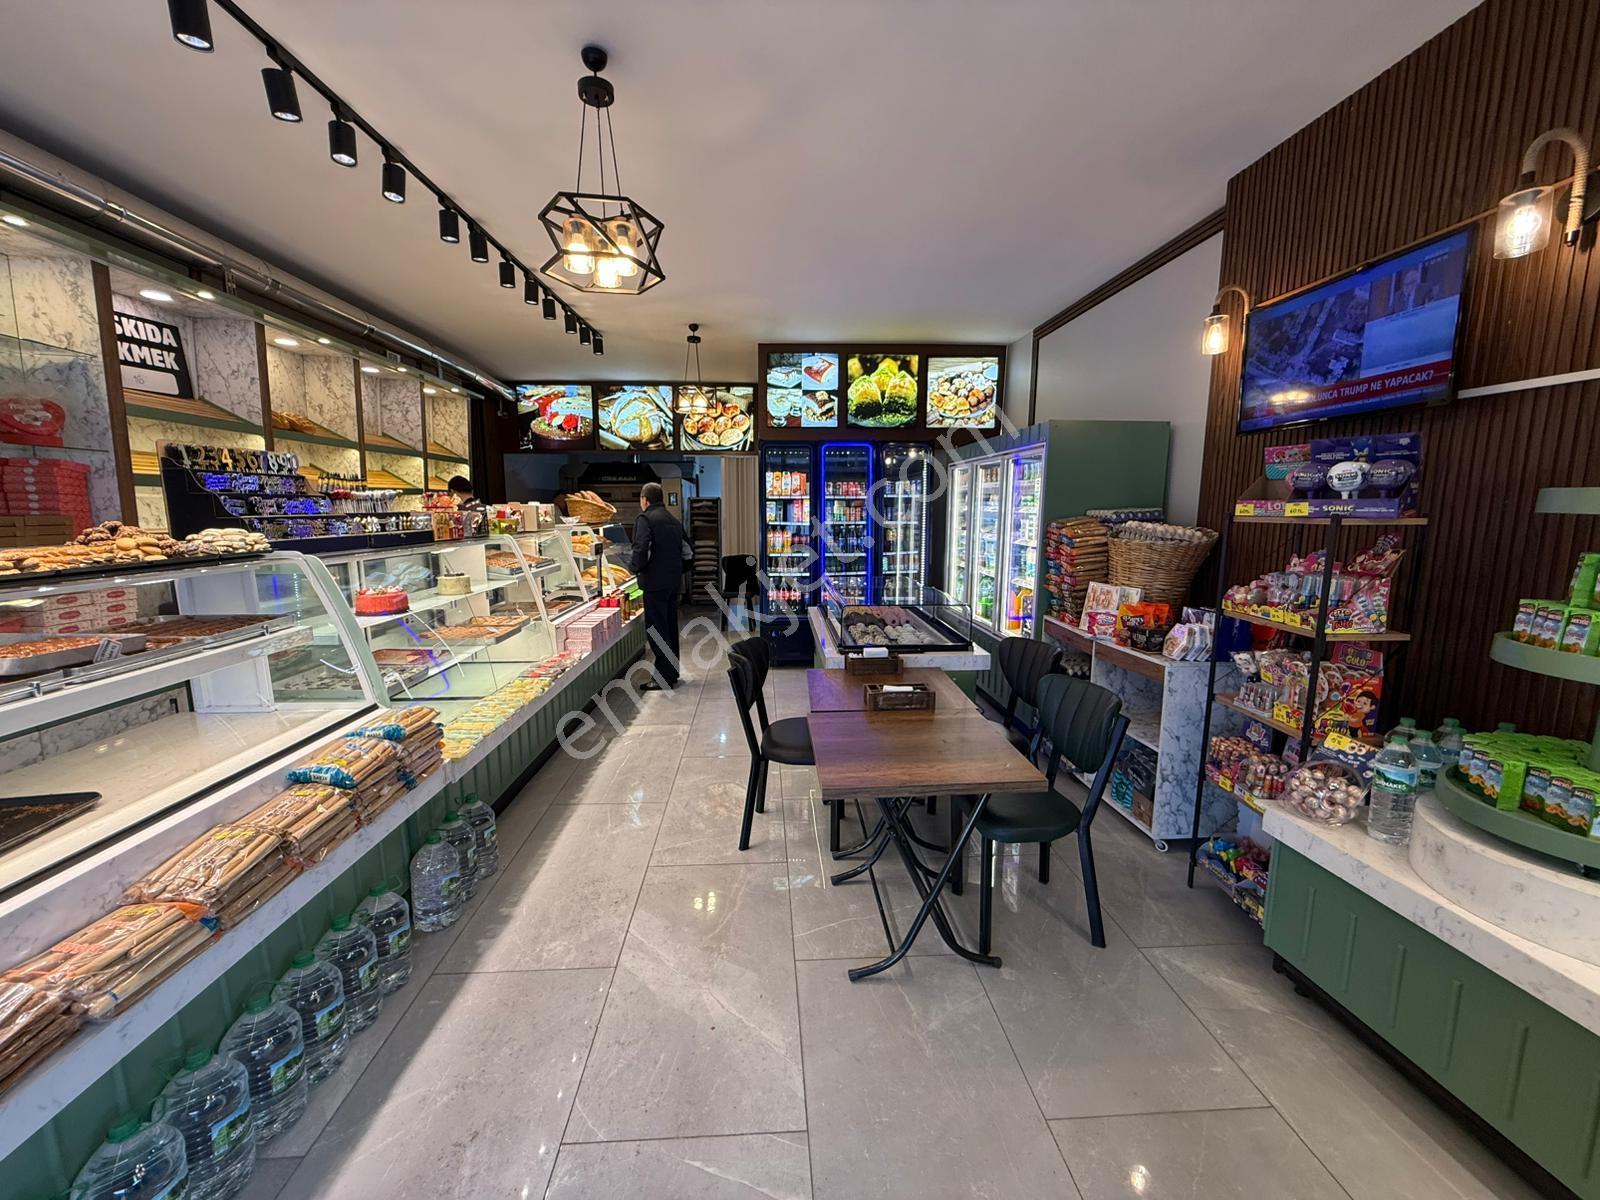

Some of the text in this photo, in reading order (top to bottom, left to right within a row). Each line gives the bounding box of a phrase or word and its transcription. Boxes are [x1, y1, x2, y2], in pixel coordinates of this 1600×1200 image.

[1340, 383, 1369, 398] TRUMP
[1370, 381, 1383, 392] NE
[1384, 370, 1435, 388] YAPACAK?
[1322, 504, 1354, 512] SONIC
